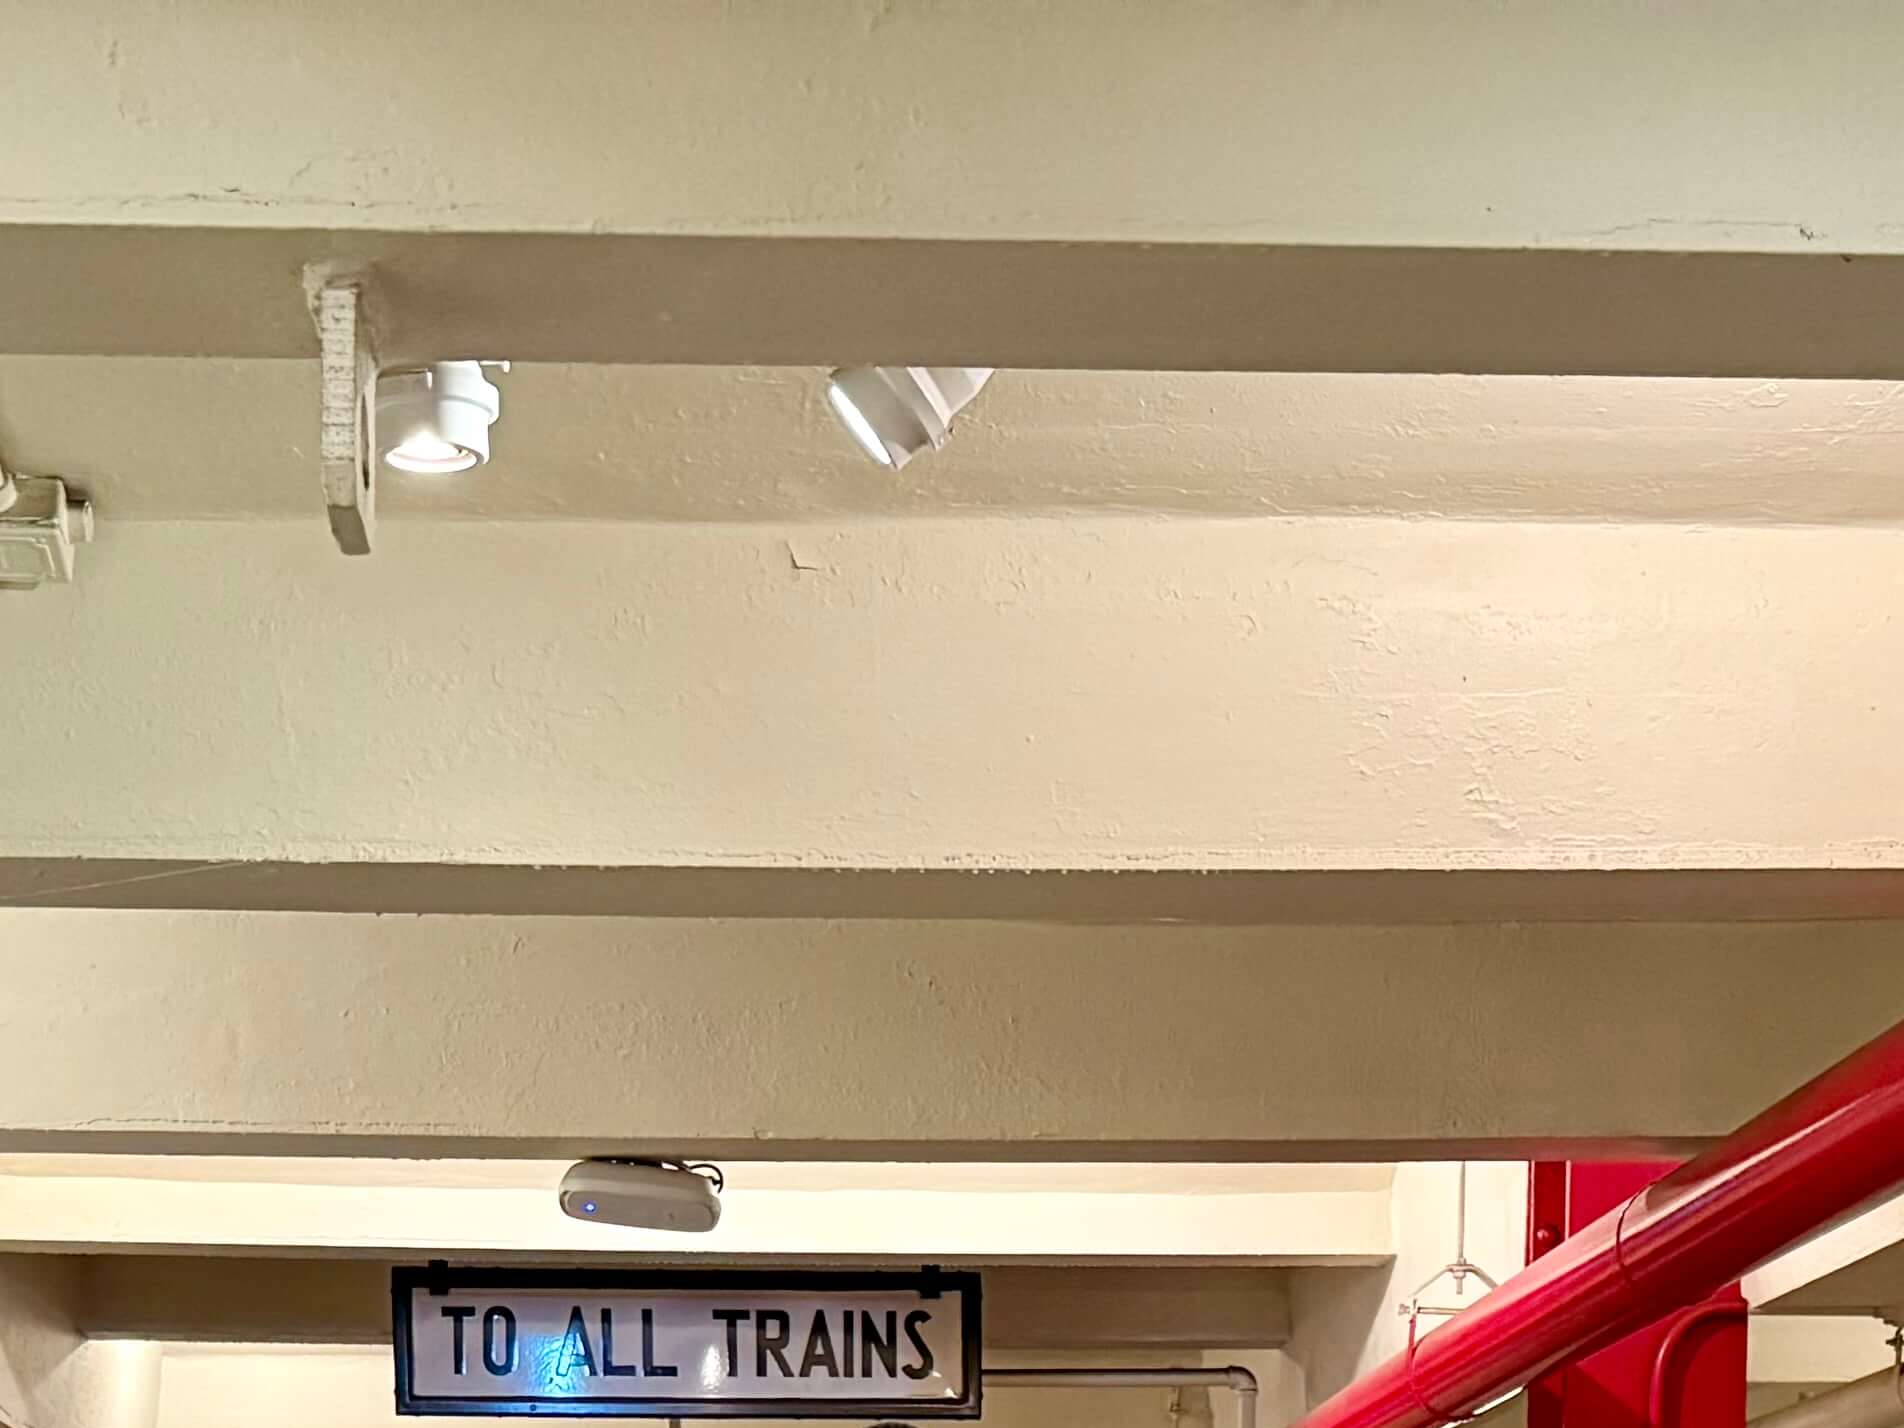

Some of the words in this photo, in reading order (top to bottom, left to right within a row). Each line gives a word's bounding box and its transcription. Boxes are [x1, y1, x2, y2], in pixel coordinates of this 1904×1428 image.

[441, 1305, 517, 1376] TO
[555, 1306, 677, 1378] ALL
[712, 1309, 933, 1380] TRAINS
